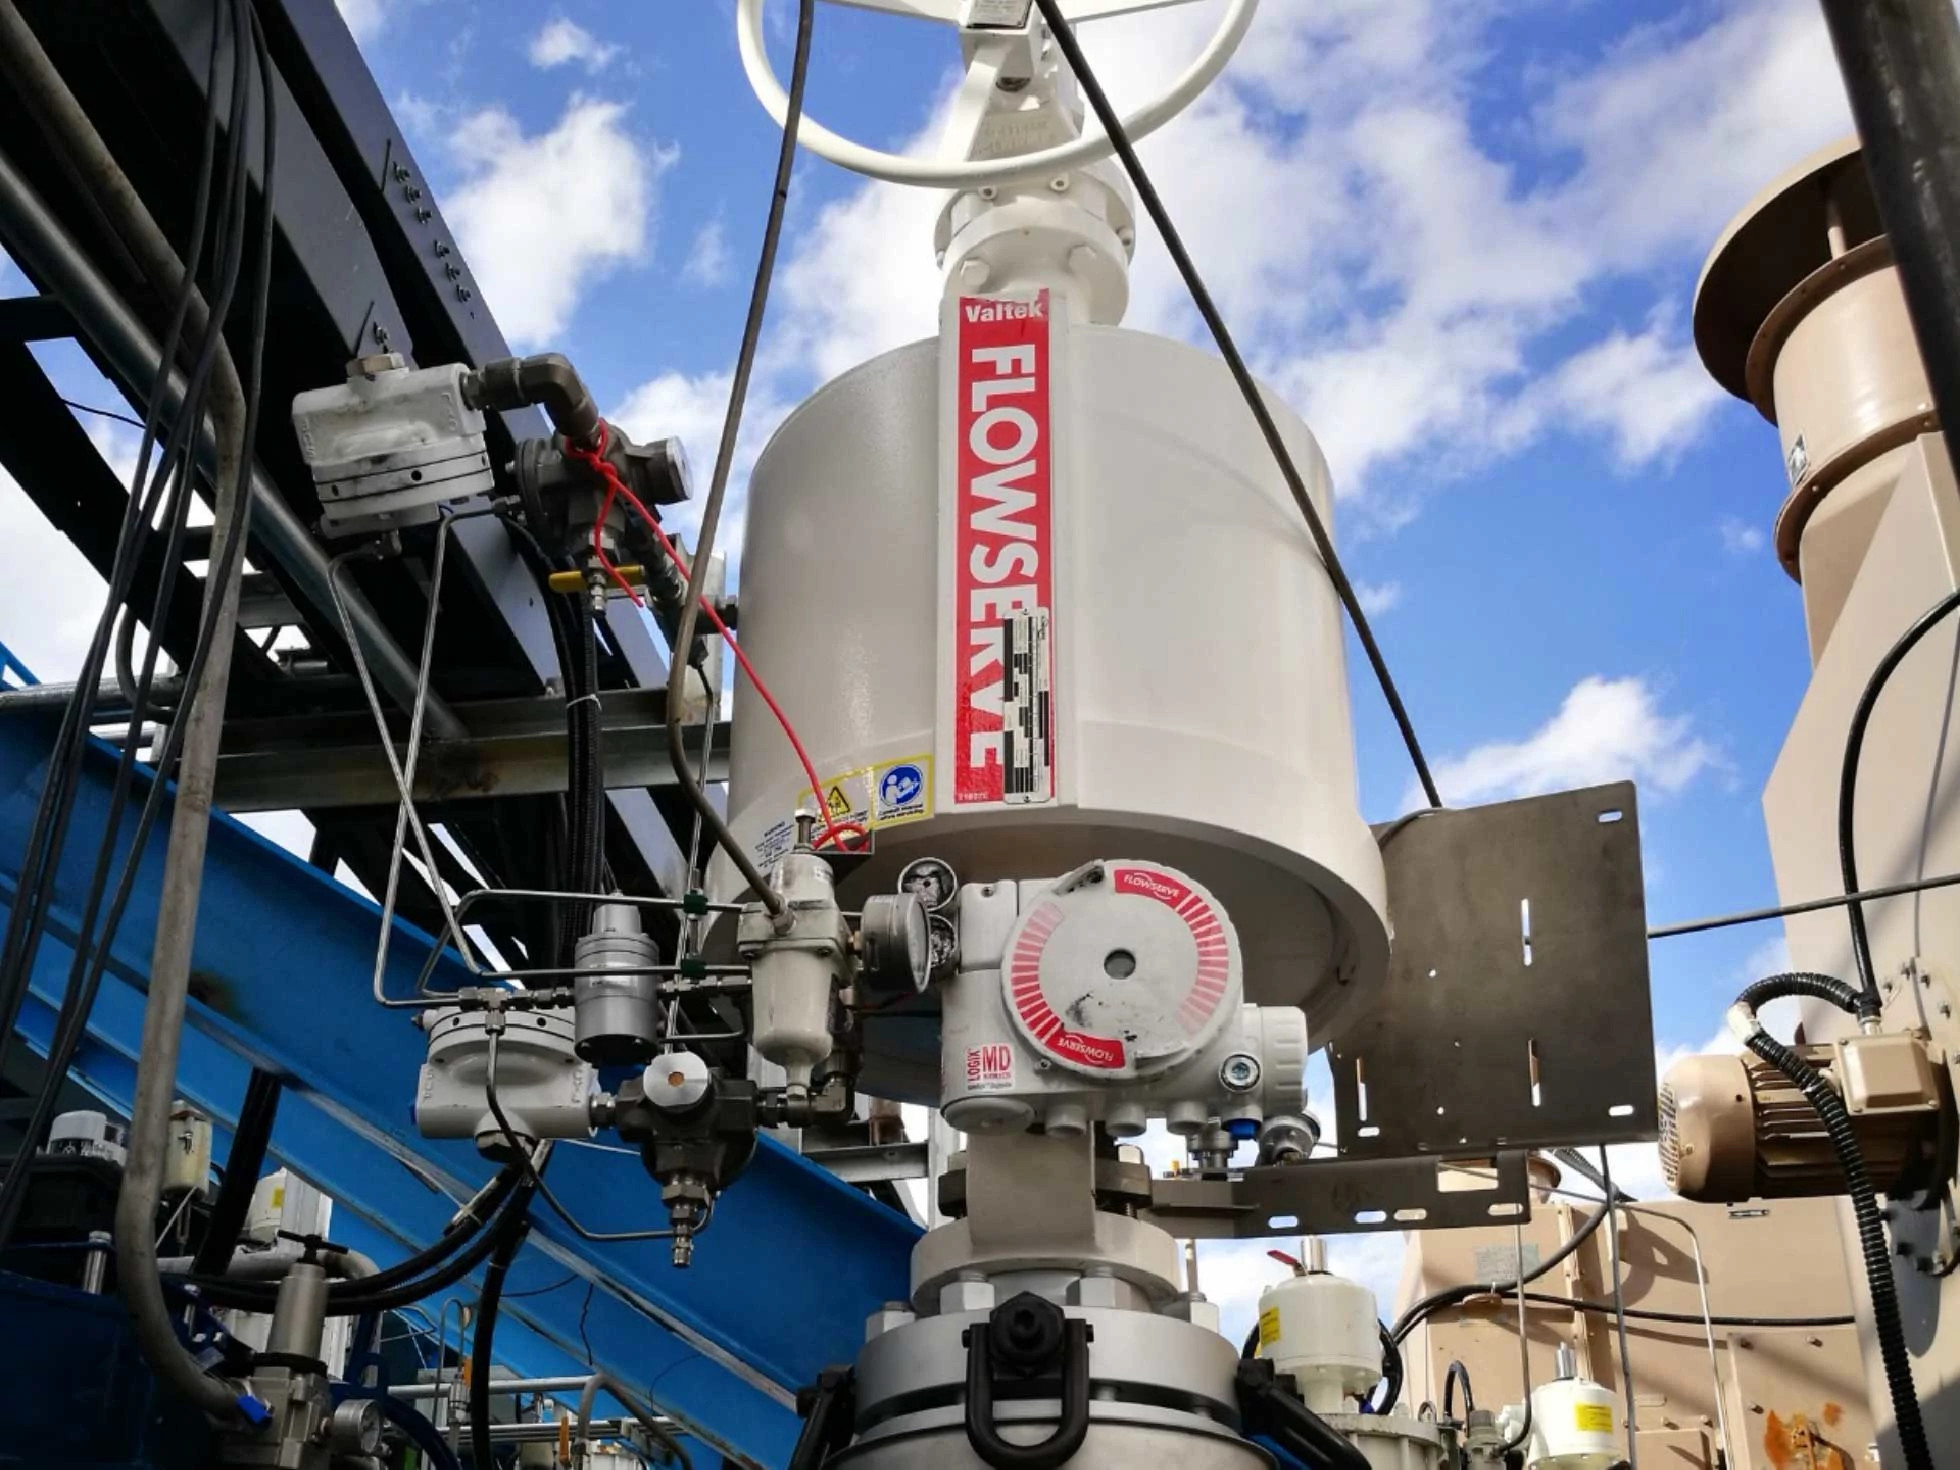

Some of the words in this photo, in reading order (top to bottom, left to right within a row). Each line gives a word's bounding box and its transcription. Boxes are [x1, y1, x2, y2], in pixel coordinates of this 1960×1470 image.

[966, 301, 1043, 323] Valtek
[1123, 874, 1180, 898] FLOWSERVE
[982, 1046, 1011, 1073] MD
[1057, 1038, 1114, 1062] FLOWSERVE
[967, 1050, 981, 1082] LOGIX
